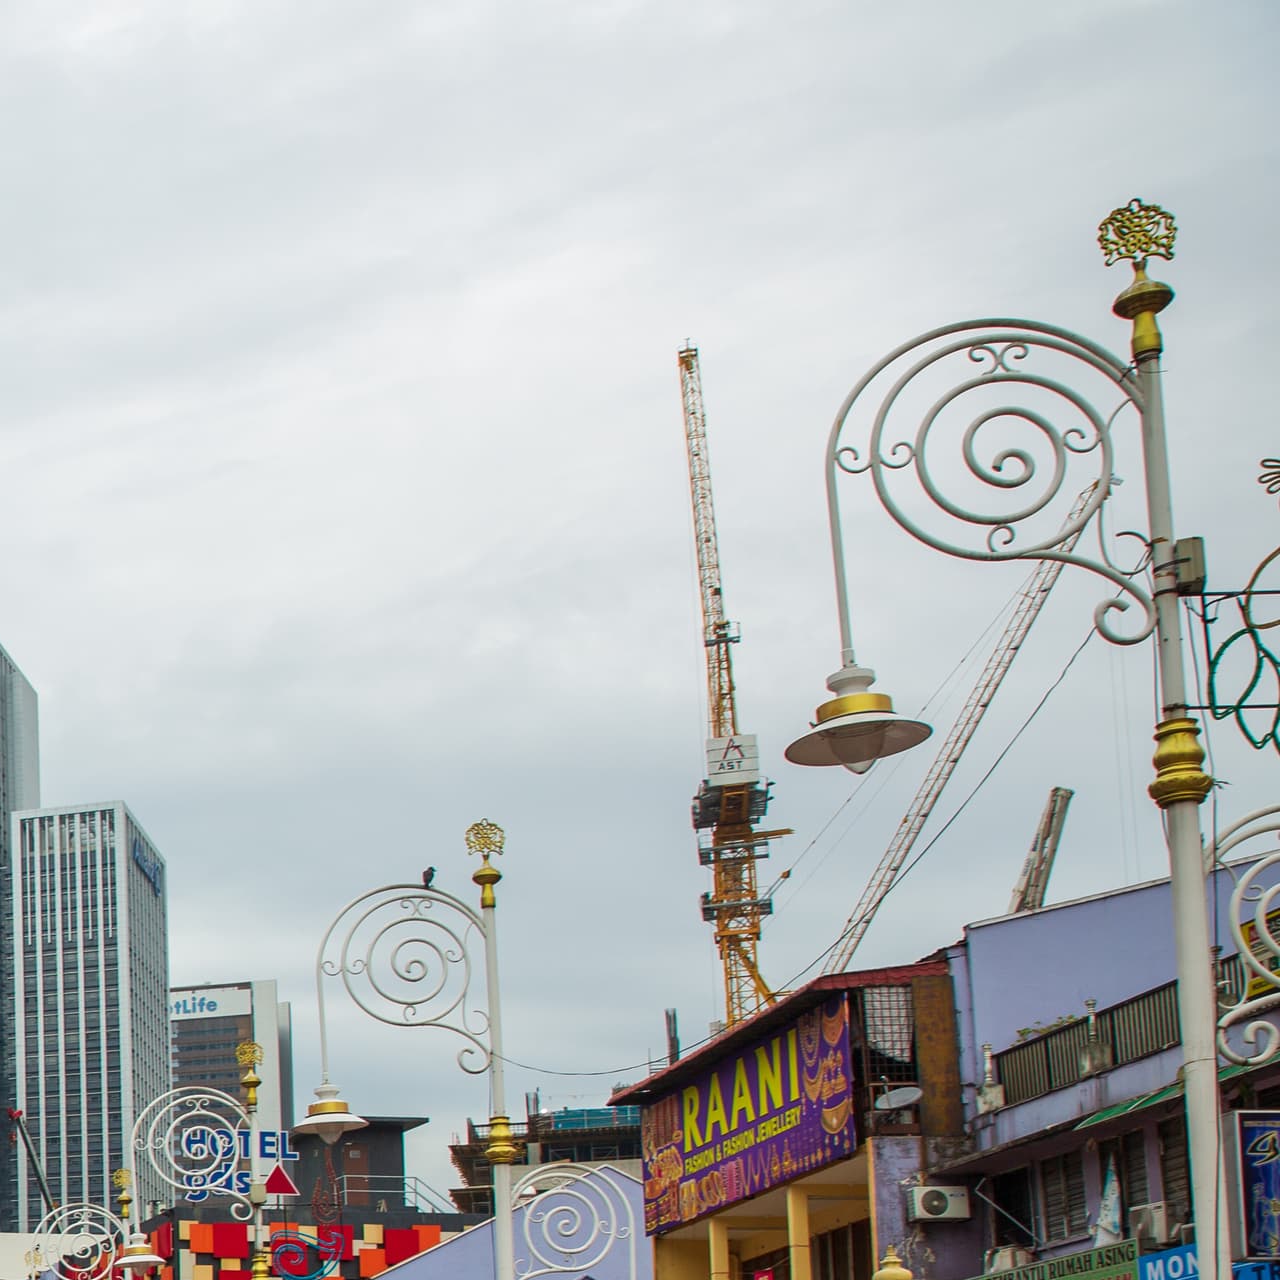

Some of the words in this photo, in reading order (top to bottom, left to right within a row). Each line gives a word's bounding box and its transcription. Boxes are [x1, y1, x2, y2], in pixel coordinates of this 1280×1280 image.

[682, 1028, 801, 1153] RAANI
[180, 1127, 300, 1161] HOTEL
[684, 1149, 716, 1176] FASHION
[722, 1129, 755, 1157] FASHION
[755, 1104, 802, 1143] JEWELLERY
[1048, 1253, 1094, 1280] RUMAH
[1096, 1244, 1136, 1268] ASING
